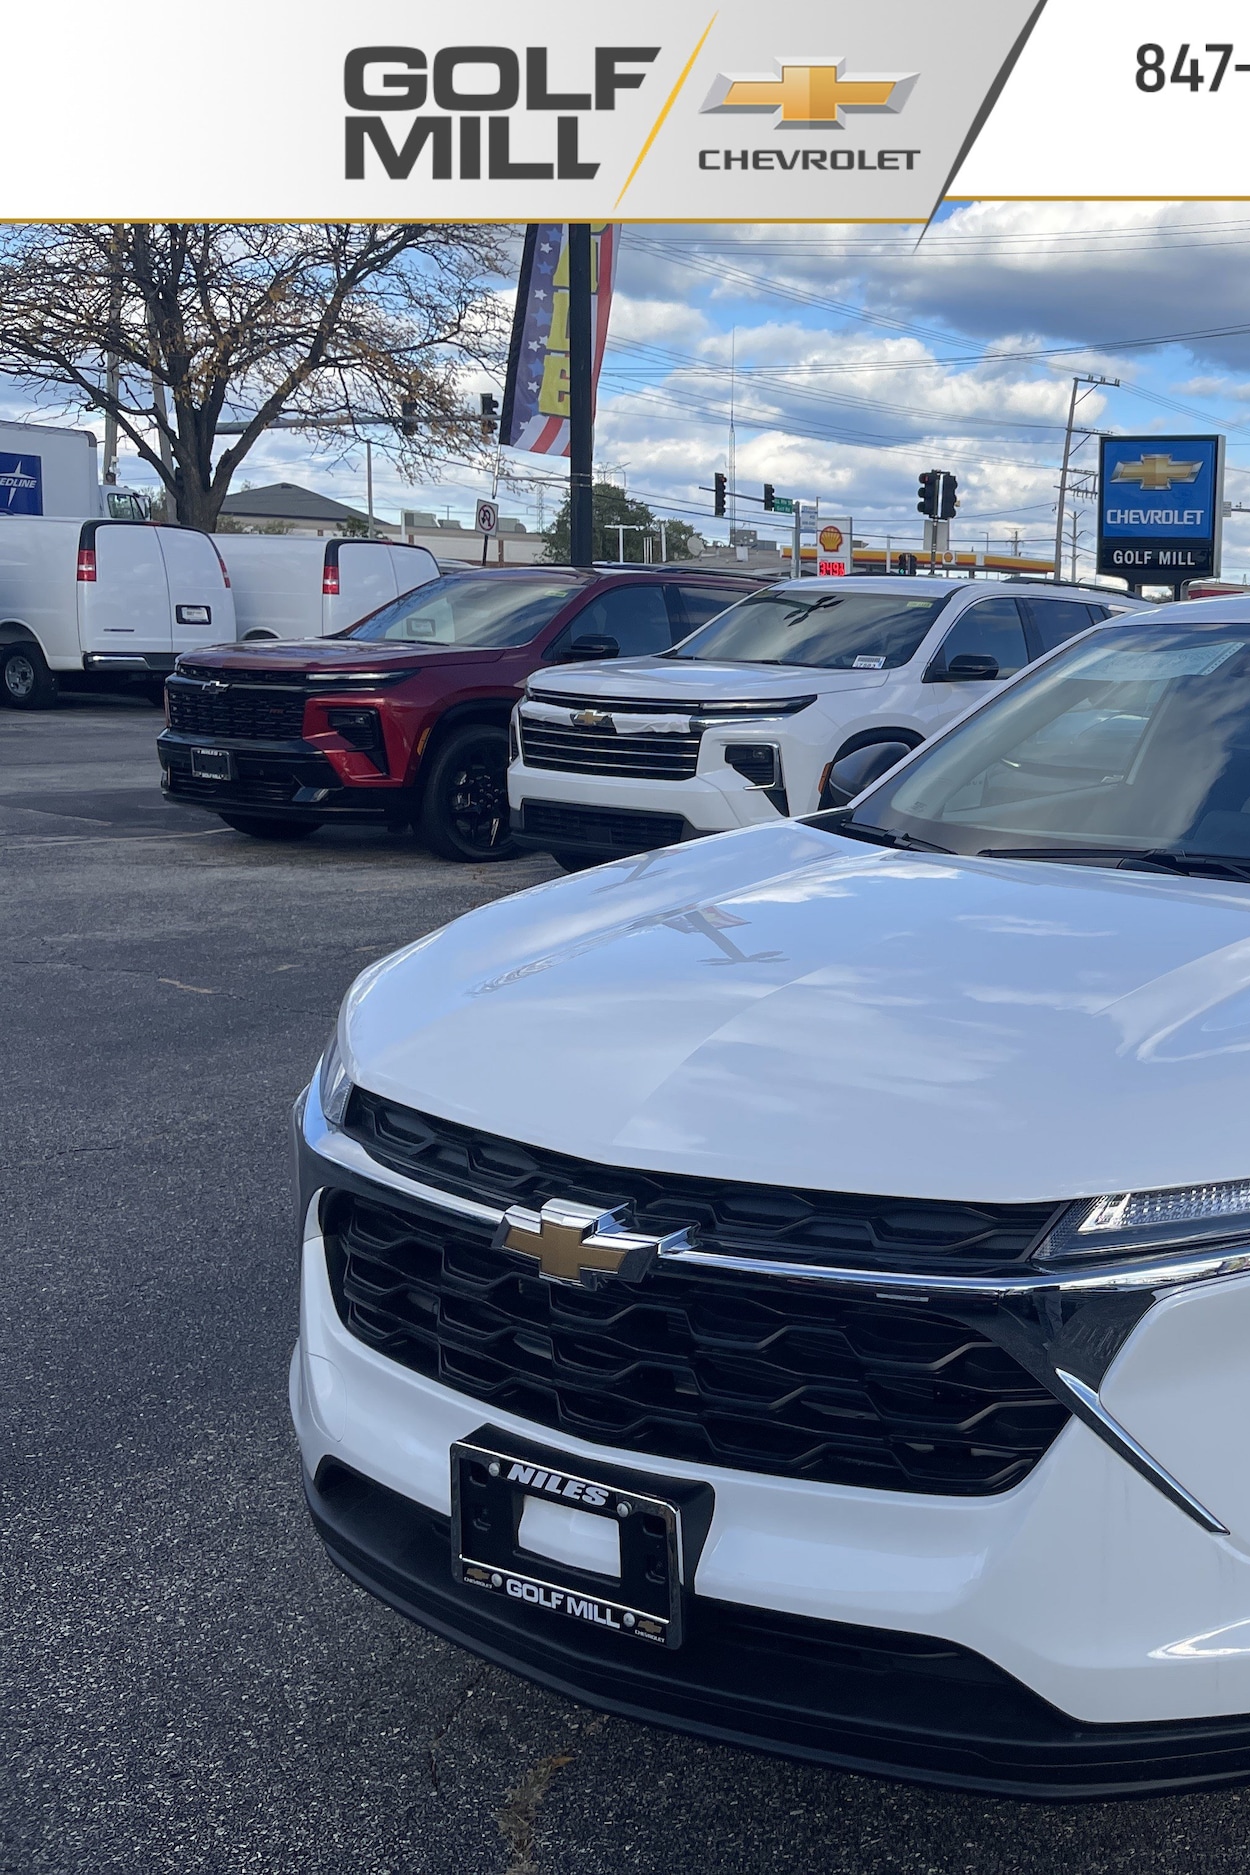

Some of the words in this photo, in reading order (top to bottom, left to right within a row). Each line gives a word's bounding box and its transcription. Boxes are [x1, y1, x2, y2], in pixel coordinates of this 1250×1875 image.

[1106, 509, 1204, 525] CHEVROLET
[1113, 550, 1152, 565] GOLF
[1158, 551, 1195, 566] MILL
[507, 1463, 609, 1506] NILES
[506, 1579, 564, 1608] GOLF
[566, 1597, 621, 1629] MILL
[634, 1629, 665, 1643] CHEVROLET
